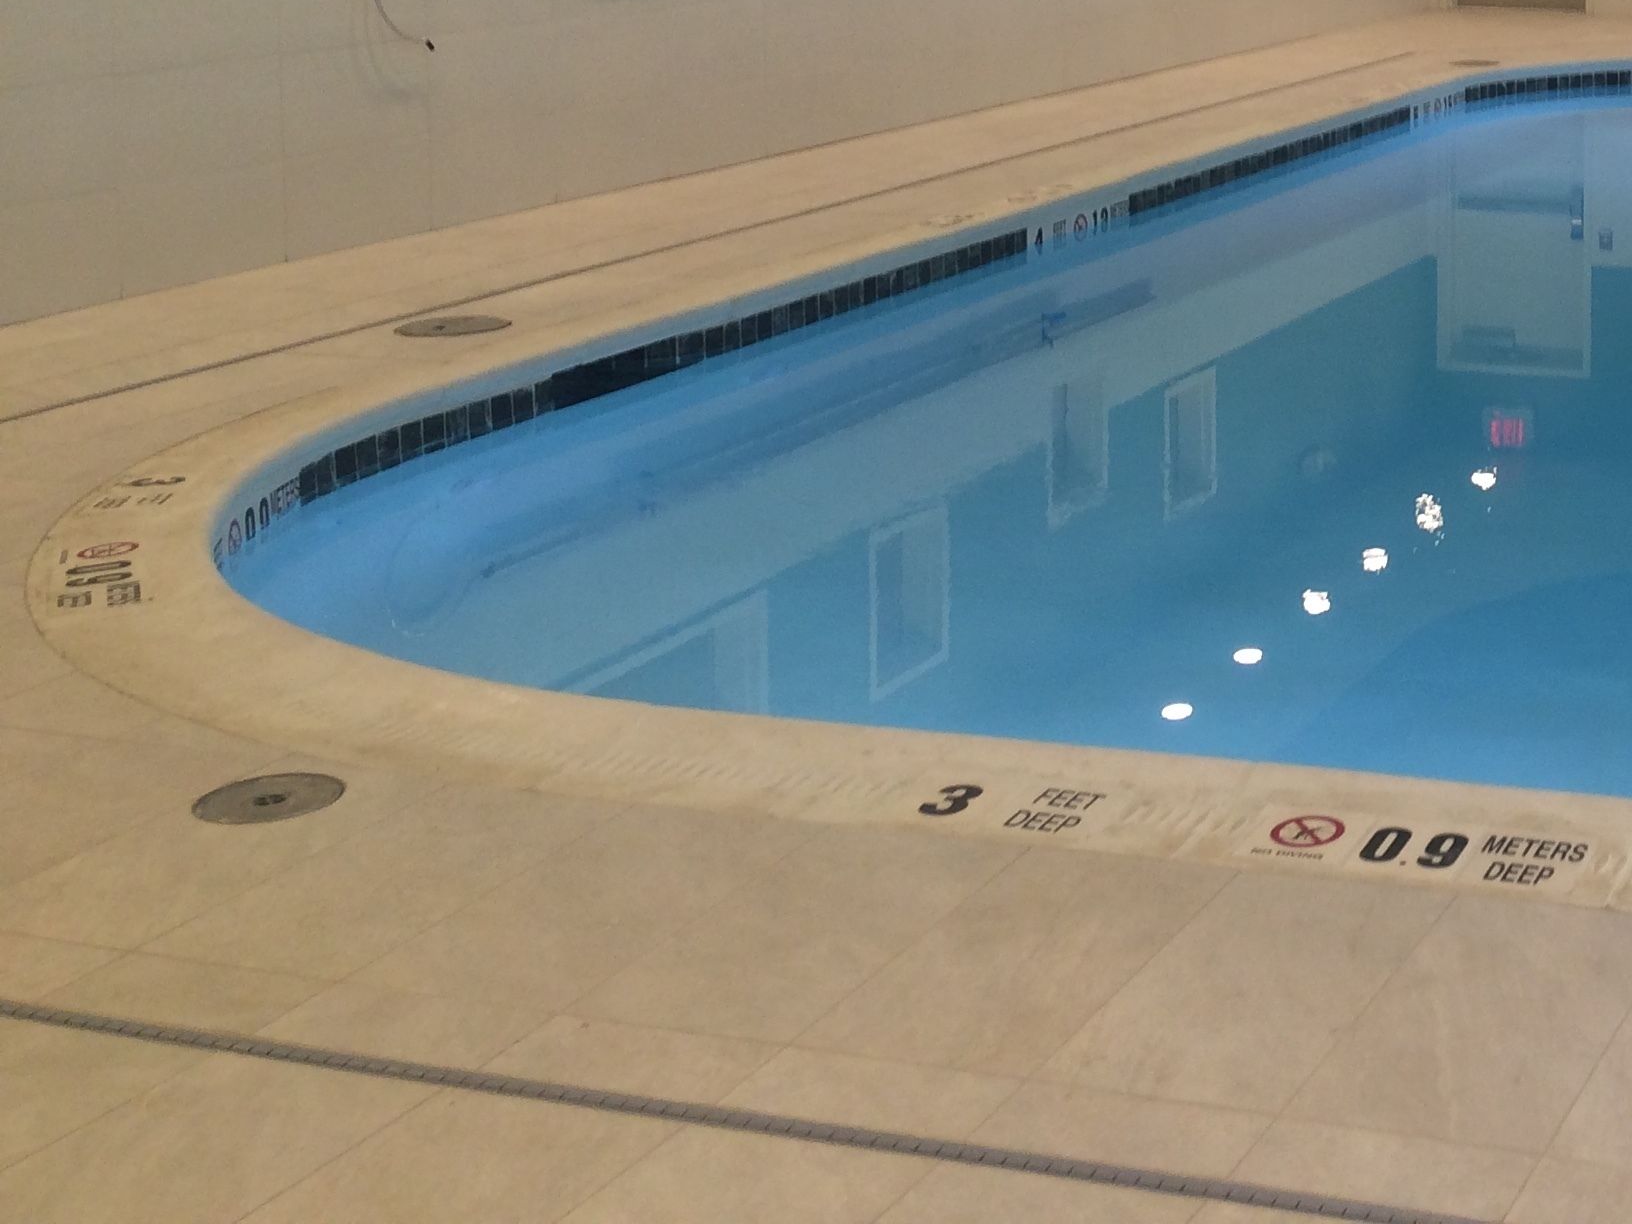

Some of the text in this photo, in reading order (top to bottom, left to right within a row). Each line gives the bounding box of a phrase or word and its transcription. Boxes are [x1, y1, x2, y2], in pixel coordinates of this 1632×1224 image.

[918, 784, 1106, 816] 3 FEET
[1003, 809, 1081, 833] DEEP
[1481, 835, 1589, 863] METERS
[1483, 861, 1555, 886] DEEP
